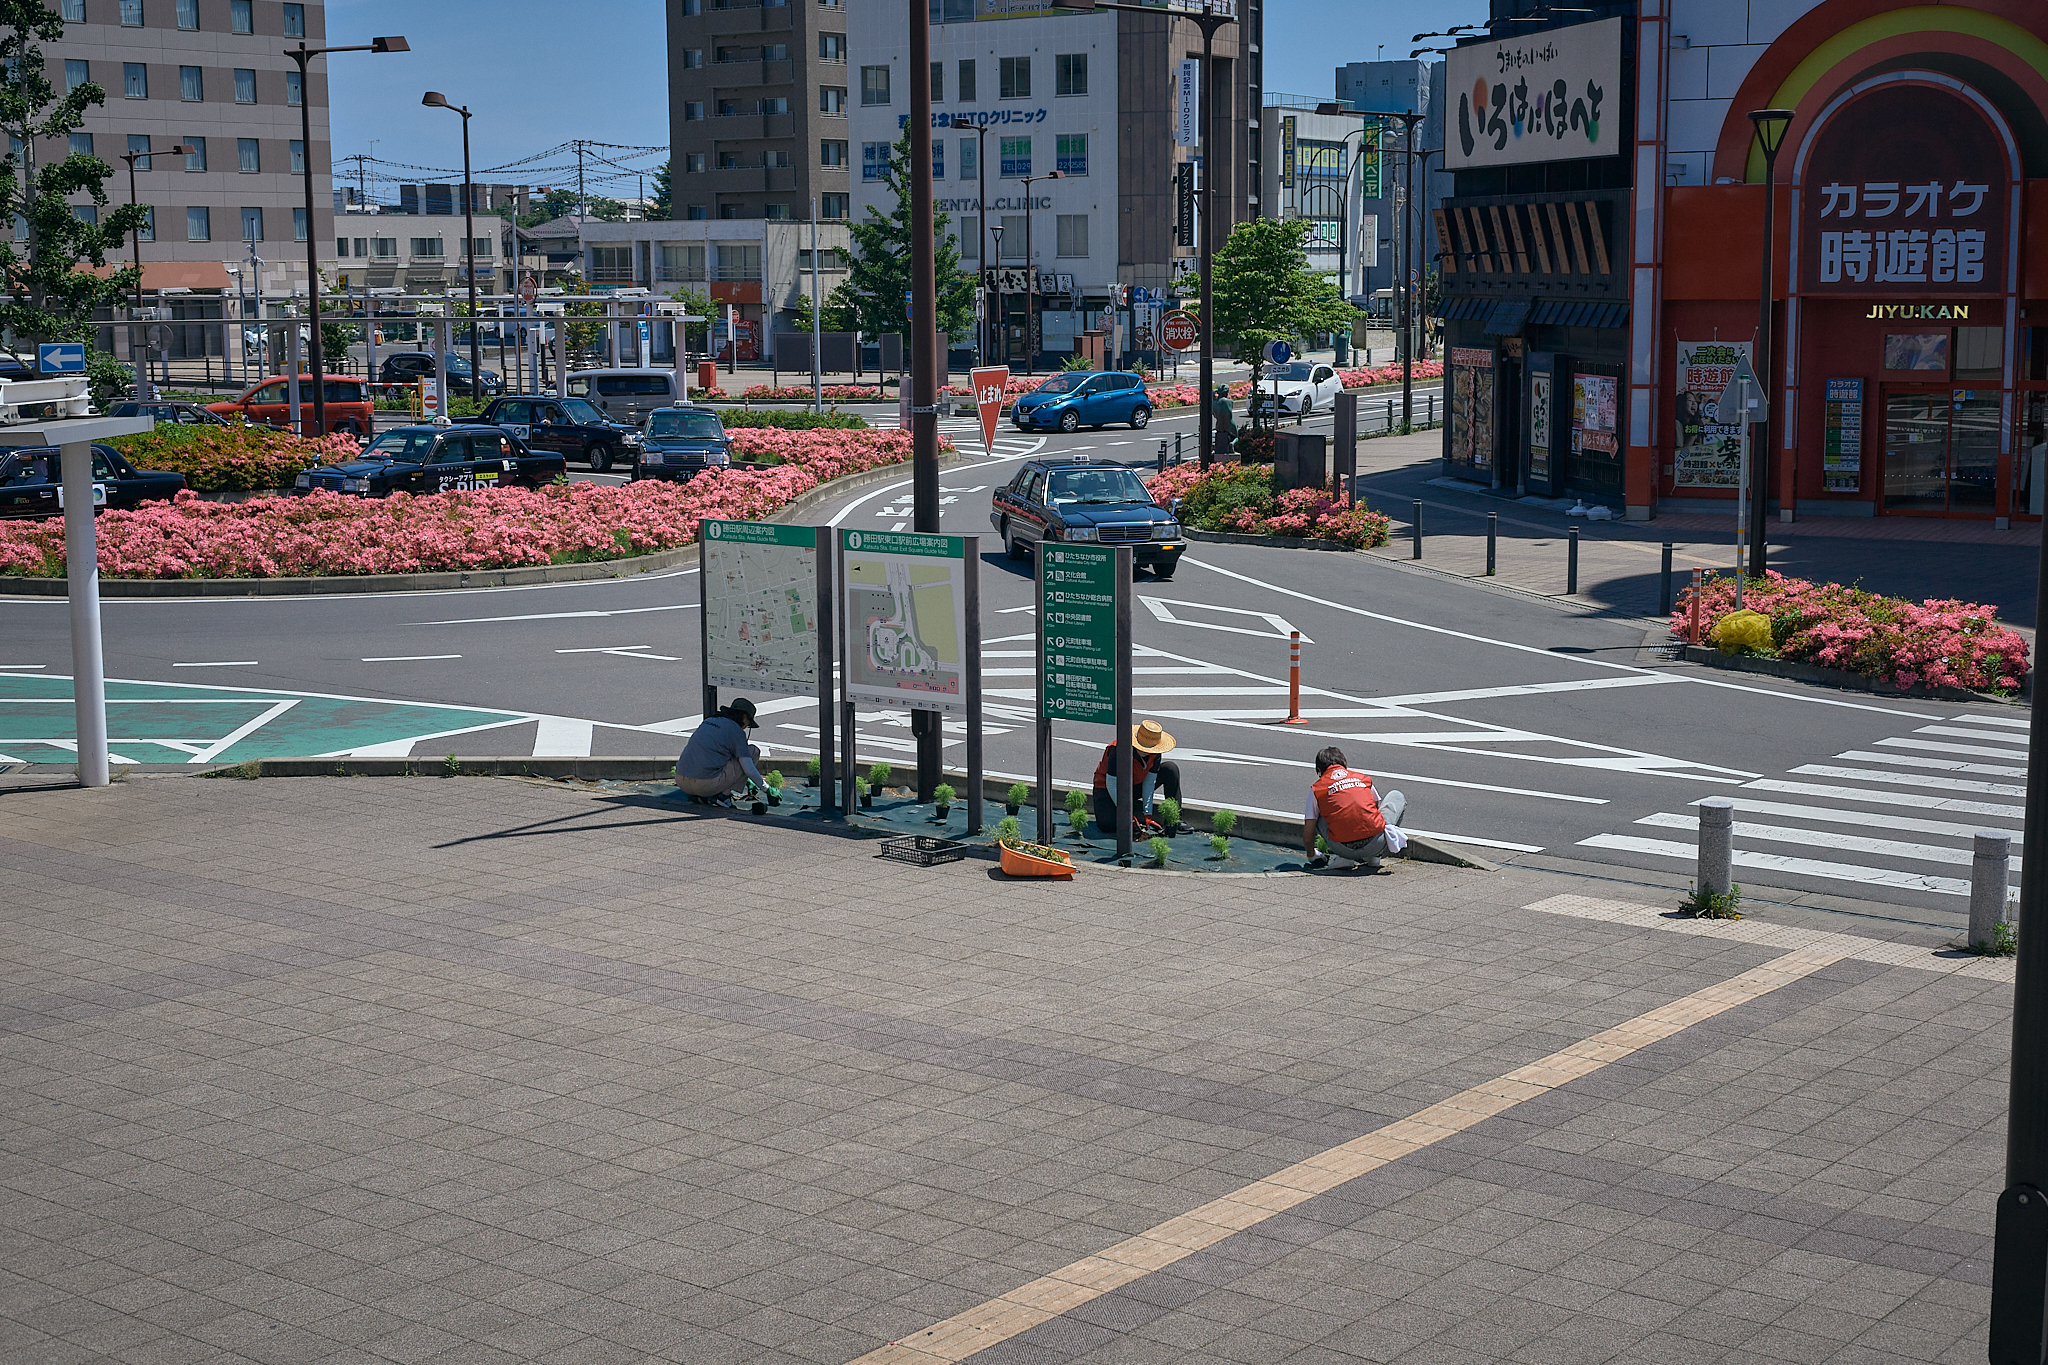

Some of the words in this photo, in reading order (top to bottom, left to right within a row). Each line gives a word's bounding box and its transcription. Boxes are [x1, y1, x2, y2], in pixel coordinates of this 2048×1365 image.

[1459, 76, 1603, 157] いろはにほへと
[1820, 181, 1989, 218] カラオケ
[1820, 229, 1986, 282] 時遊館
[1166, 327, 1192, 340] 消火栓
[1696, 346, 1734, 356] 二次会は
[980, 384, 1001, 404] 止まれ
[1829, 389, 1858, 399] 時遊館
[439, 474, 474, 482] タクシーアプリ
[723, 524, 774, 535] 勝田駅周辺案内図
[864, 534, 947, 548] 勝田駅東口駅前広場案内図
[1065, 553, 1106, 562] ひたちなか市役所
[1065, 571, 1086, 579] 文化会館
[1065, 593, 1112, 602] ひたちなか総合病院
[1065, 613, 1091, 621] 中央図書館
[1066, 637, 1091, 646] 元町駐車場
[1066, 674, 1091, 682] 勝田駅東口
